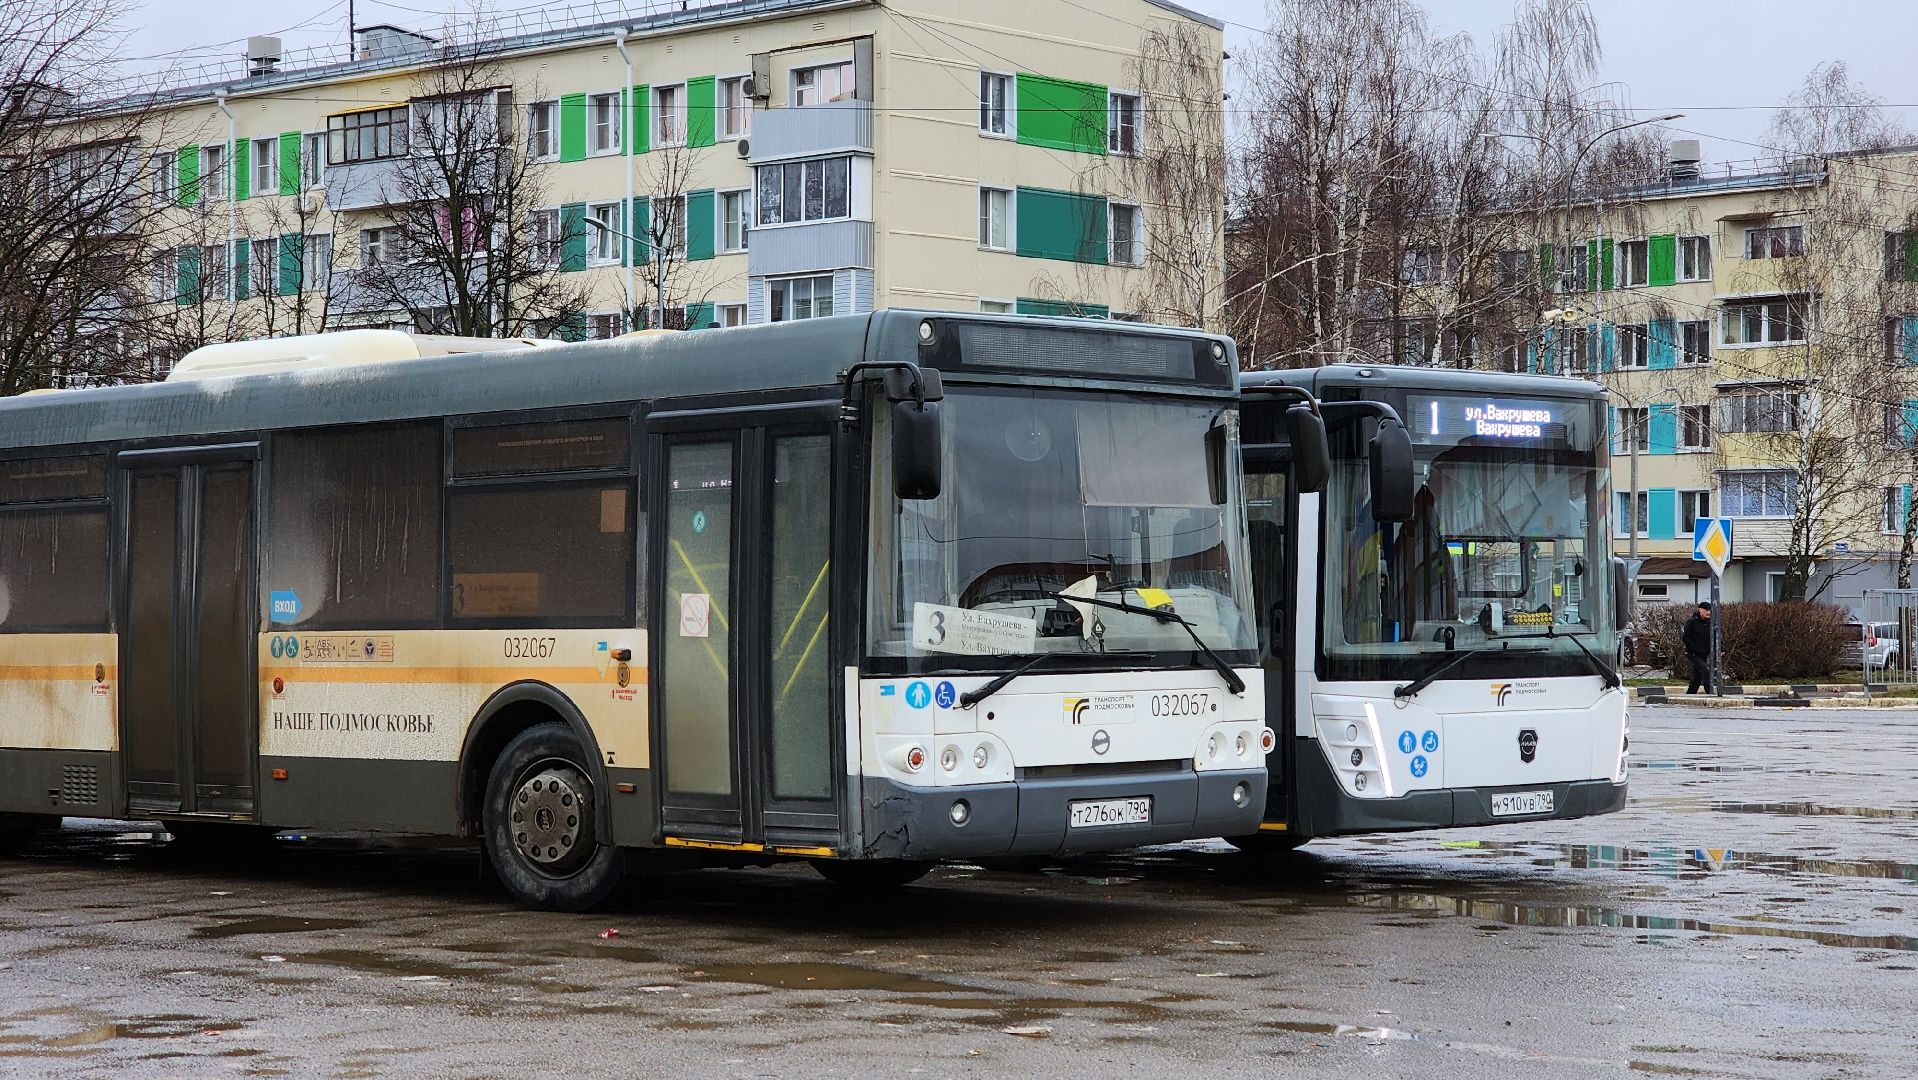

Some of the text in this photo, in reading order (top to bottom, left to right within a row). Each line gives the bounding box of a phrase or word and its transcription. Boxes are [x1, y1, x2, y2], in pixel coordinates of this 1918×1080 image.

[1431, 401, 1438, 434] 1
[1476, 420, 1541, 438] Вахрушева
[274, 600, 296, 614] ВХОД
[928, 610, 946, 646] 3
[504, 637, 556, 658] 032067
[1094, 703, 1135, 711] ПОДМОСКОВЬЯ
[1151, 693, 1209, 717] 032067
[273, 712, 435, 734] НАШЕ ПОДМОСКОВЬЕ
